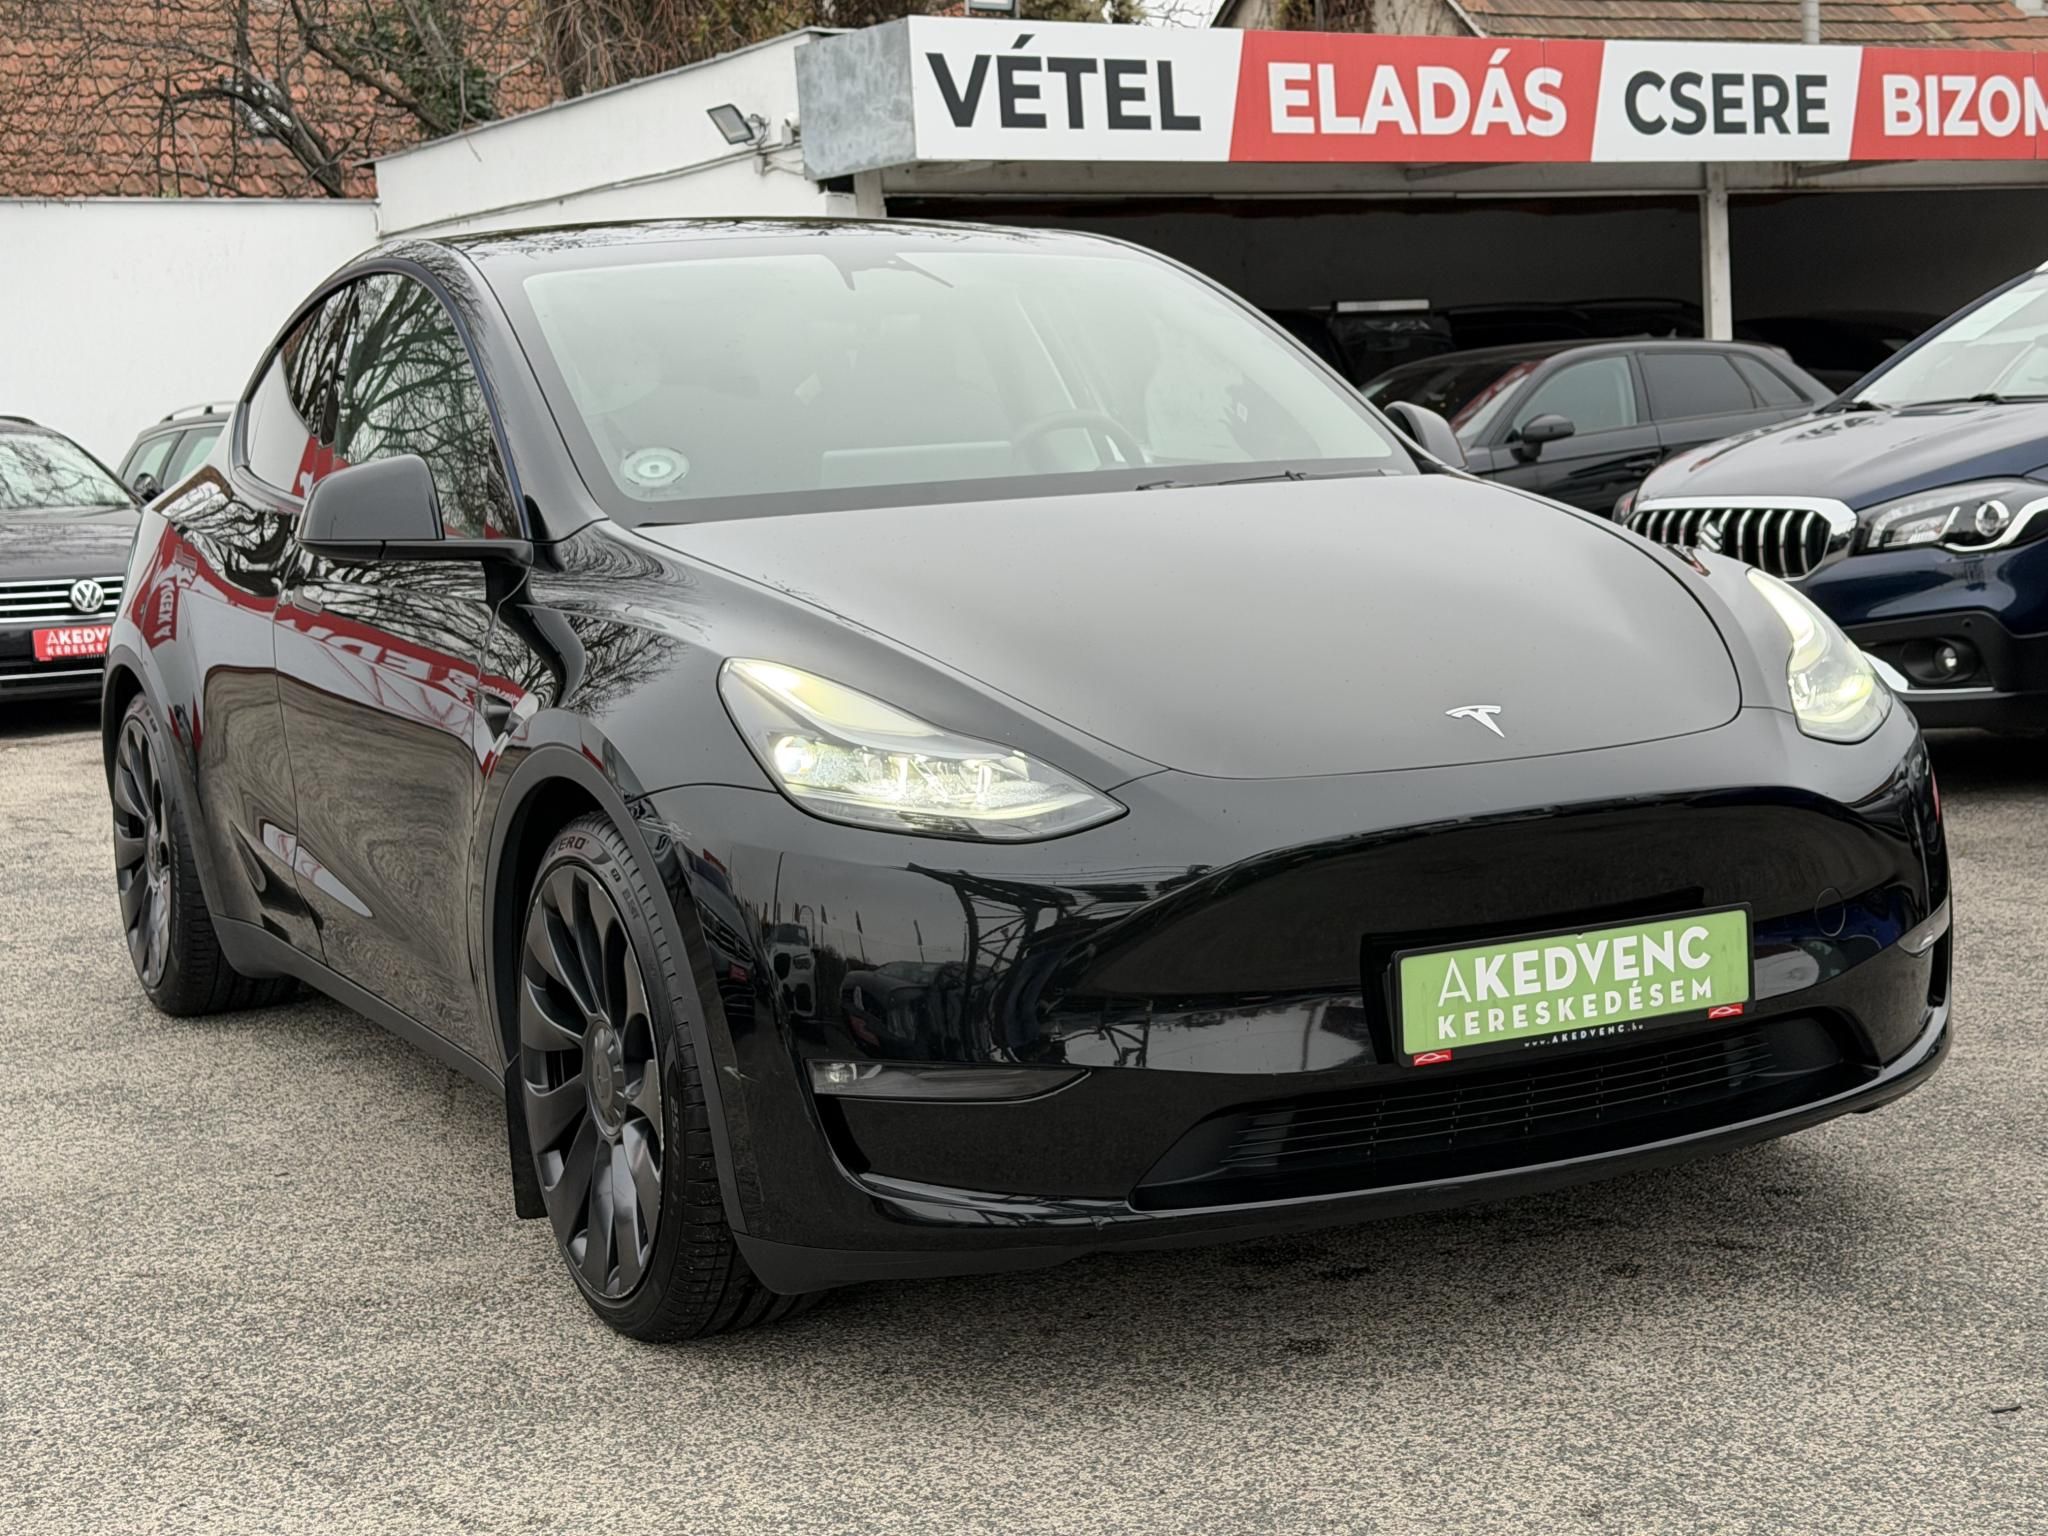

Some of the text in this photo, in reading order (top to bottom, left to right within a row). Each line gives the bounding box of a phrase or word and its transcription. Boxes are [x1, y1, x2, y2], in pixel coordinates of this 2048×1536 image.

[925, 33, 1202, 131] VÉTEL
[1267, 48, 1568, 137] ELADÁS
[1624, 70, 1830, 136] CSERE
[1438, 926, 1712, 1007] AKEDVENC
[1438, 976, 1712, 1040] KERESKEDÉSEM
